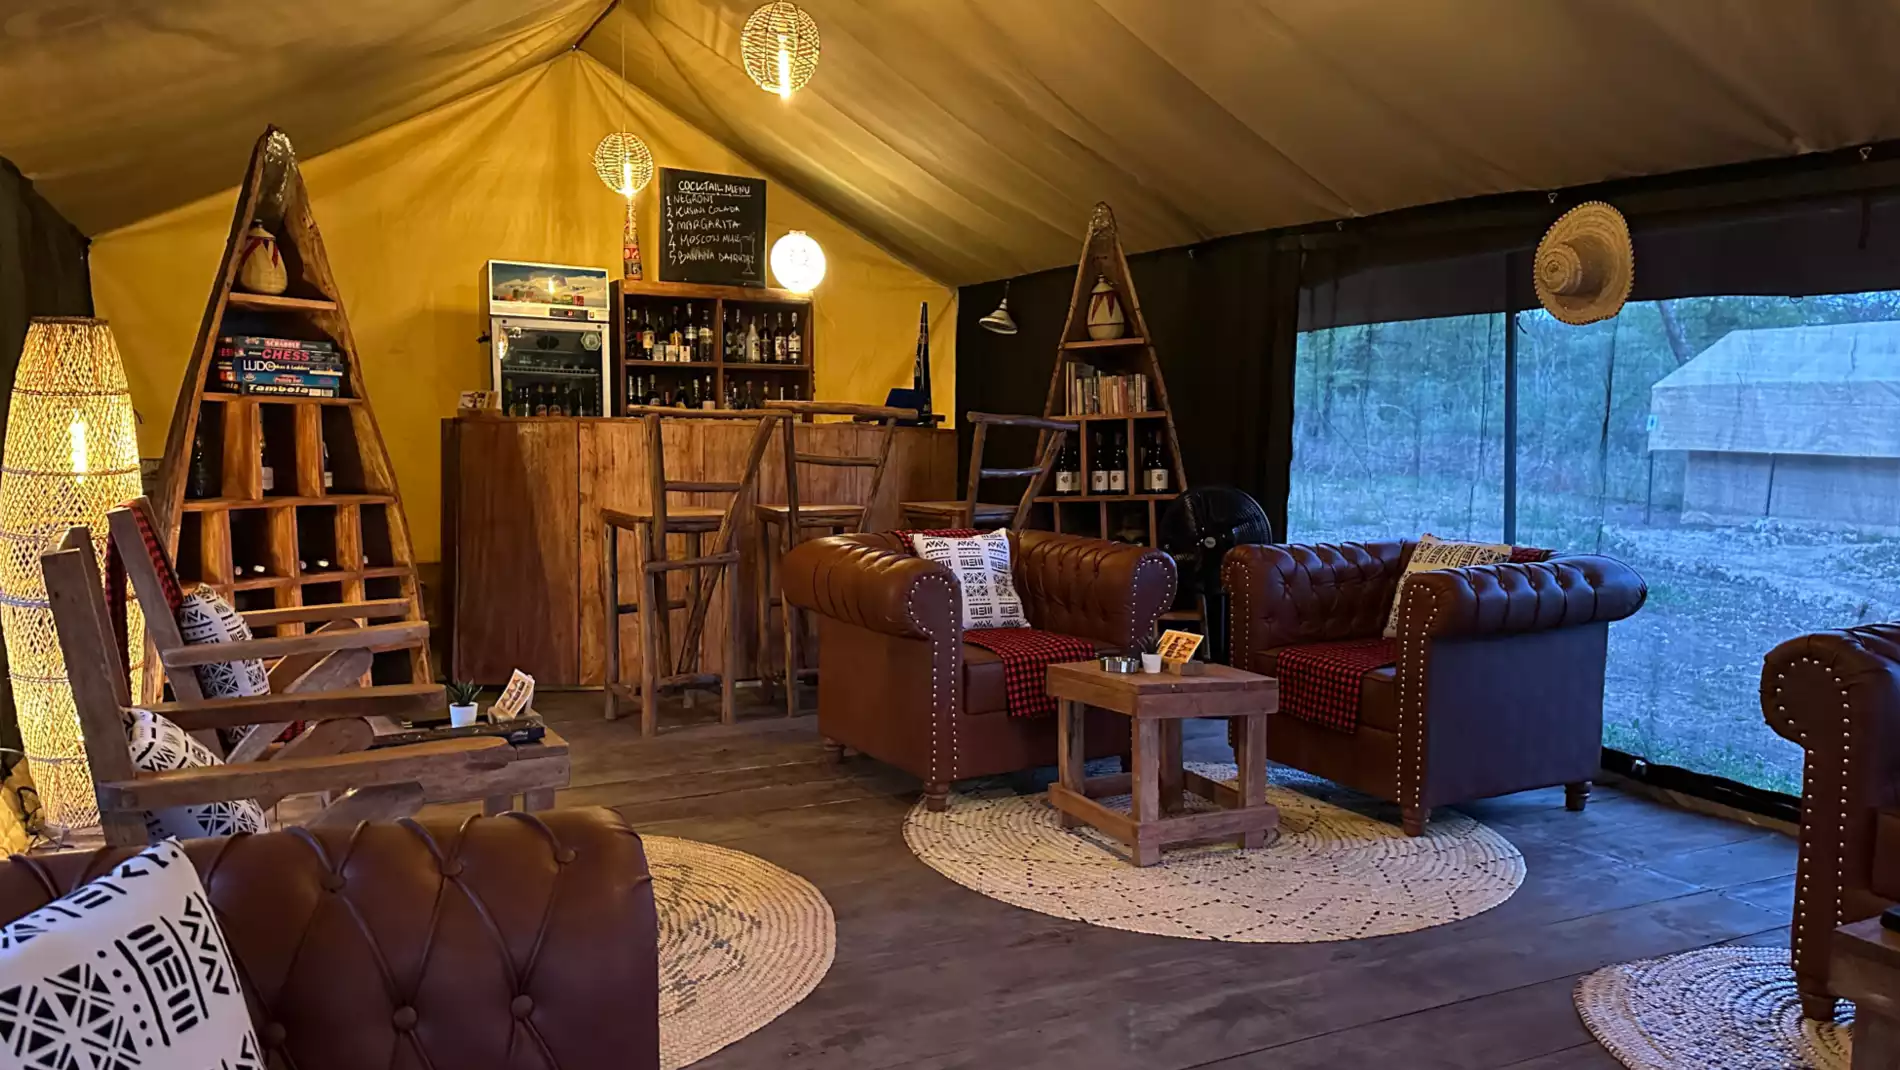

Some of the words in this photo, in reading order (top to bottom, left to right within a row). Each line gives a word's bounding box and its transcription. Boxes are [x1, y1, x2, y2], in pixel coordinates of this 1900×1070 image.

[678, 180, 723, 192] COCKTAIL
[724, 184, 751, 195] MENU
[666, 195, 672, 206] 1
[673, 194, 714, 204] NEGRONI
[666, 207, 674, 218] 2
[667, 219, 674, 233] 3
[676, 218, 742, 231] MARGARITA
[668, 234, 677, 251] 4
[680, 234, 720, 247] MOSCOW
[669, 250, 677, 266] 5
[677, 249, 715, 265] BANANA
[264, 338, 301, 349] SCRABBLE
[261, 349, 310, 361] CHESS
[243, 359, 276, 372] LUDO
[248, 384, 309, 394] Tambola
